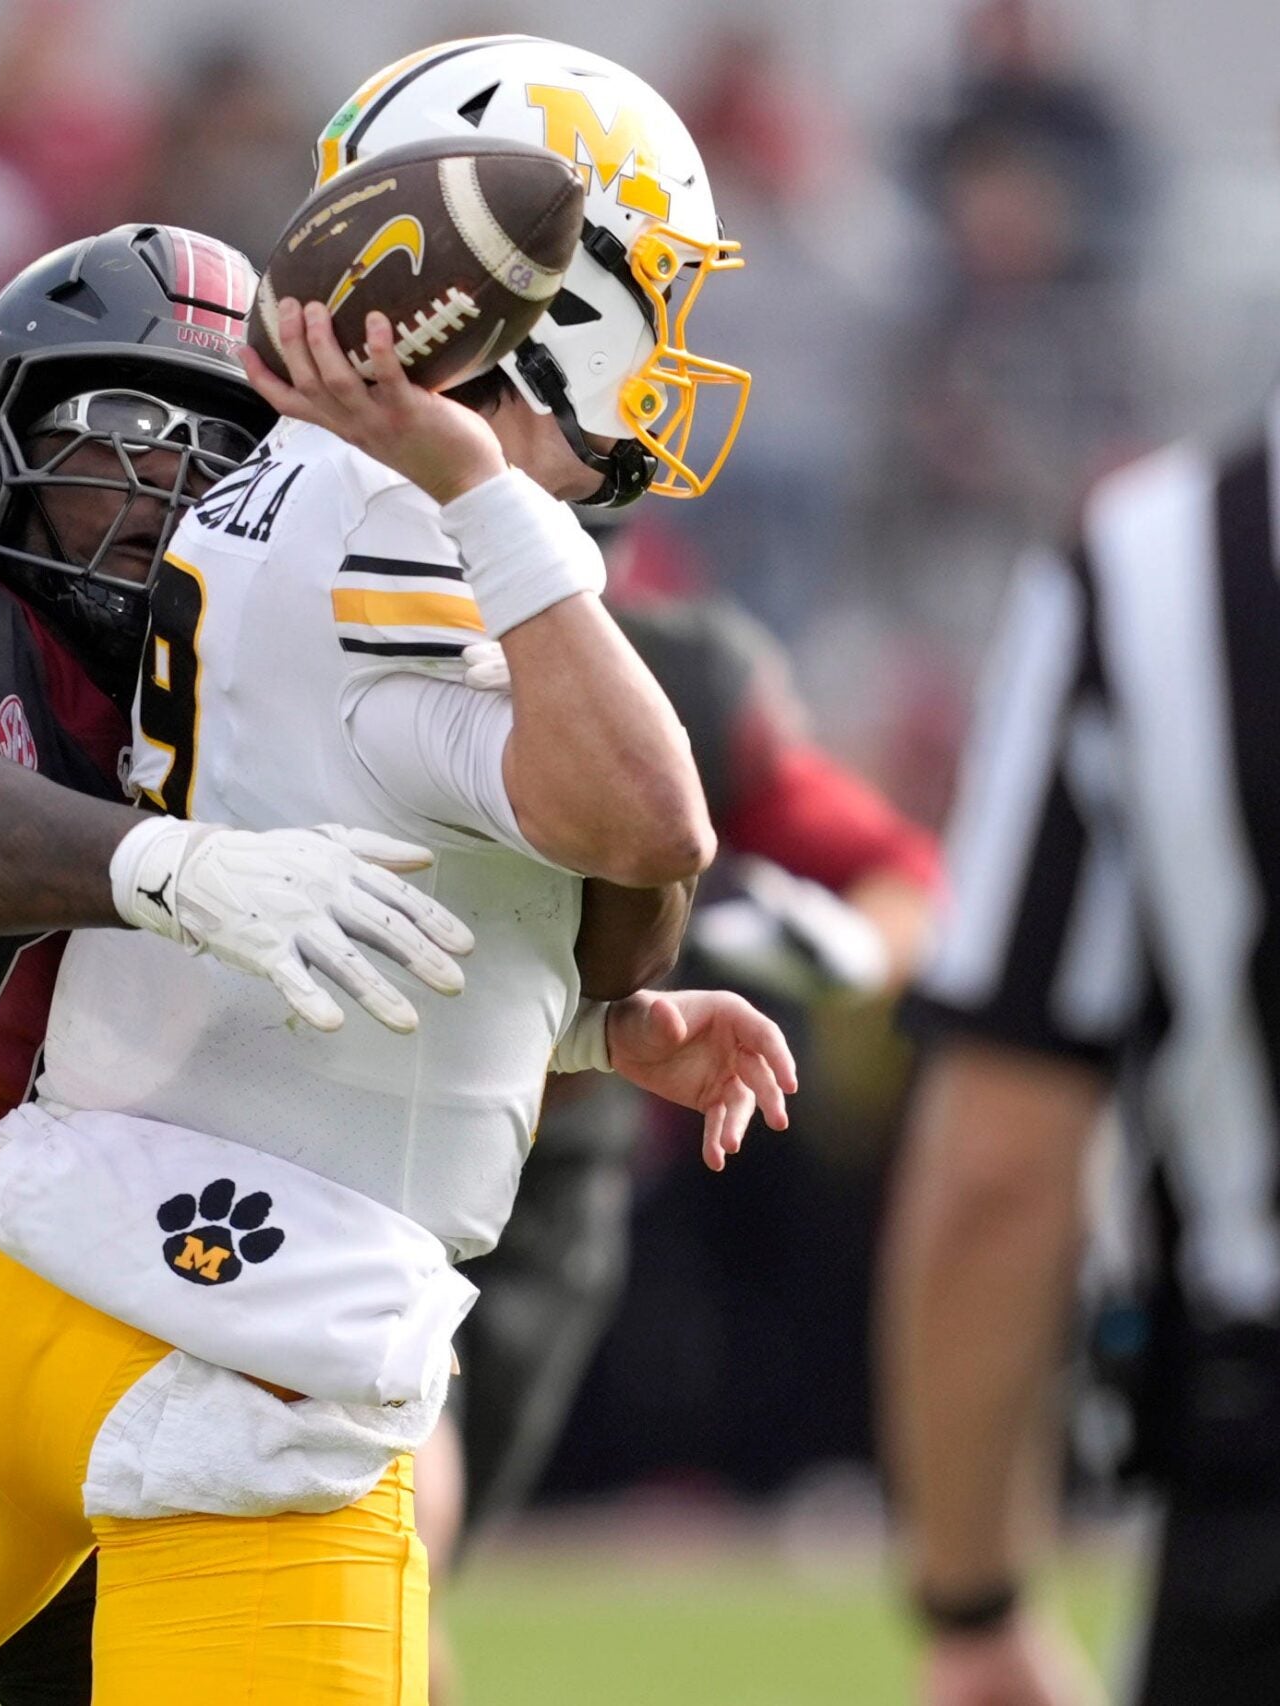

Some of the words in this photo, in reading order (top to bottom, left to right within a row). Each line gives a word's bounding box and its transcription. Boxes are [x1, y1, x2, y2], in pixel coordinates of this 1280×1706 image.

[525, 83, 671, 222] M
[178, 327, 238, 358] UNITY
[138, 552, 207, 819] 9
[174, 1235, 231, 1281] M
